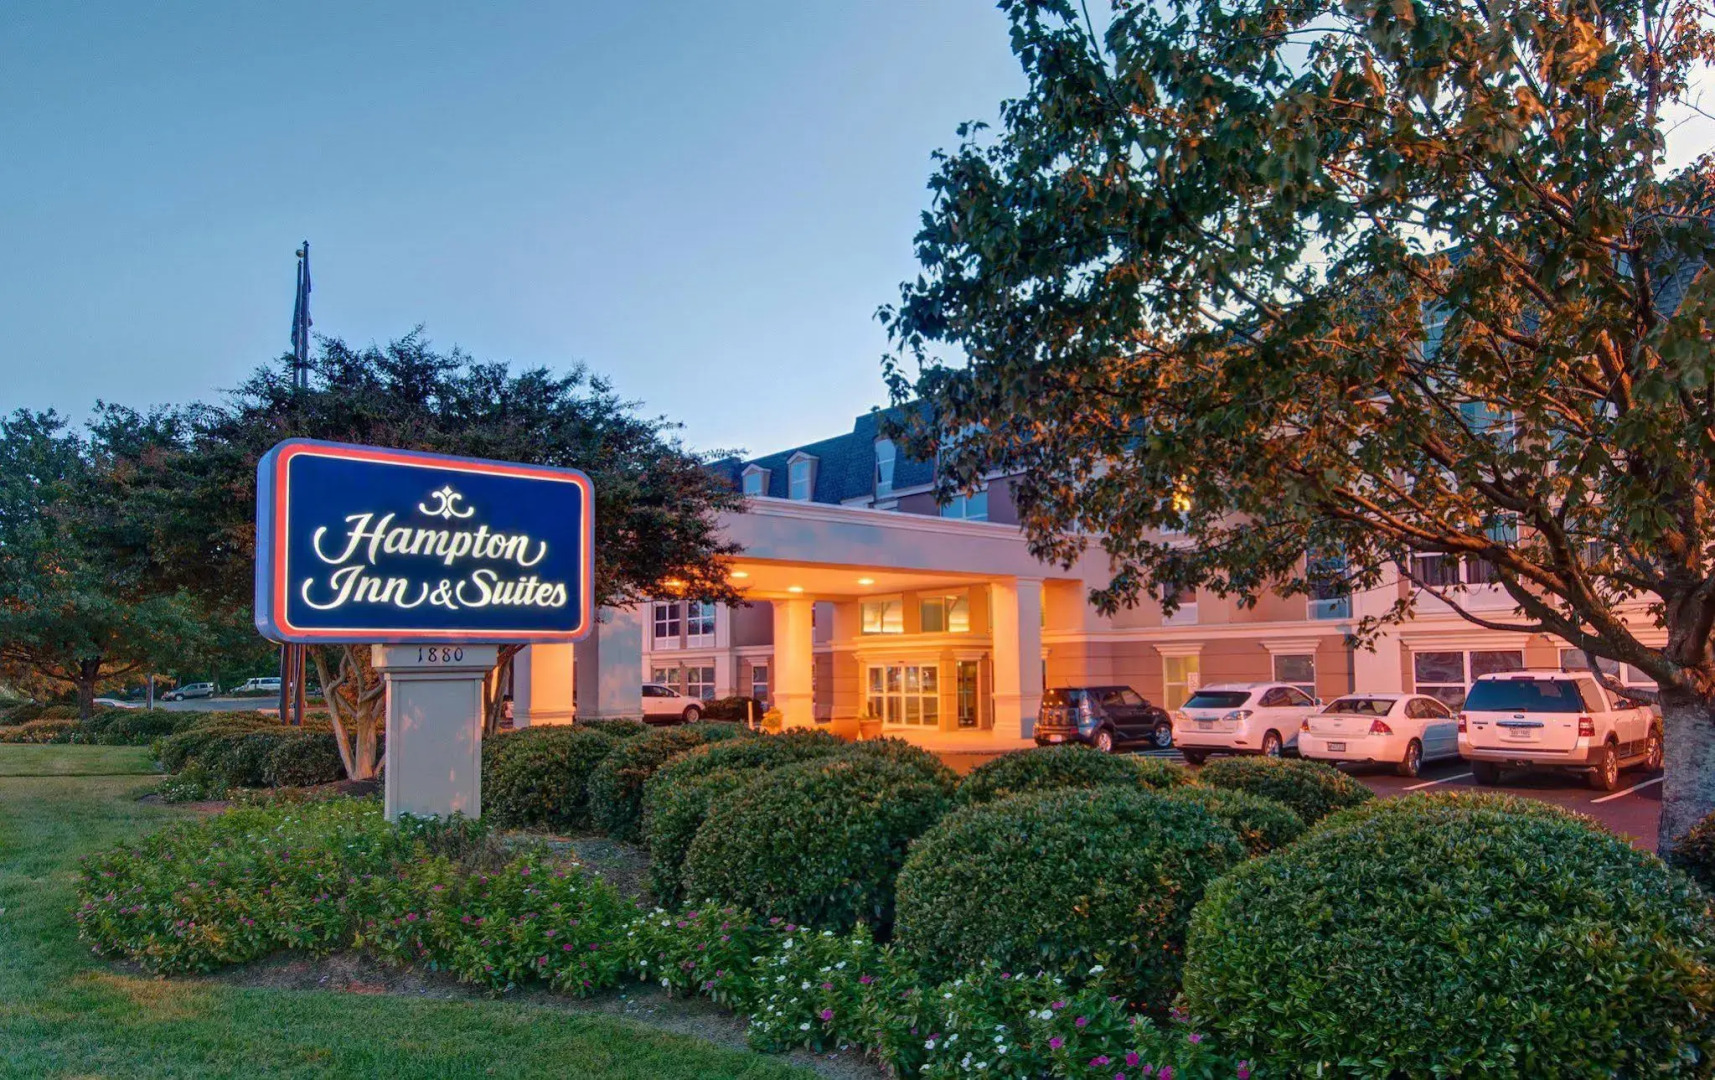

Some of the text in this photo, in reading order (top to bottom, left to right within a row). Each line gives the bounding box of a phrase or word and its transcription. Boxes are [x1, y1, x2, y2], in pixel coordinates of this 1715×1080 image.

[313, 512, 547, 566] Hampton
[301, 565, 567, 611] Inn & Suites
[416, 646, 465, 663] 1880
